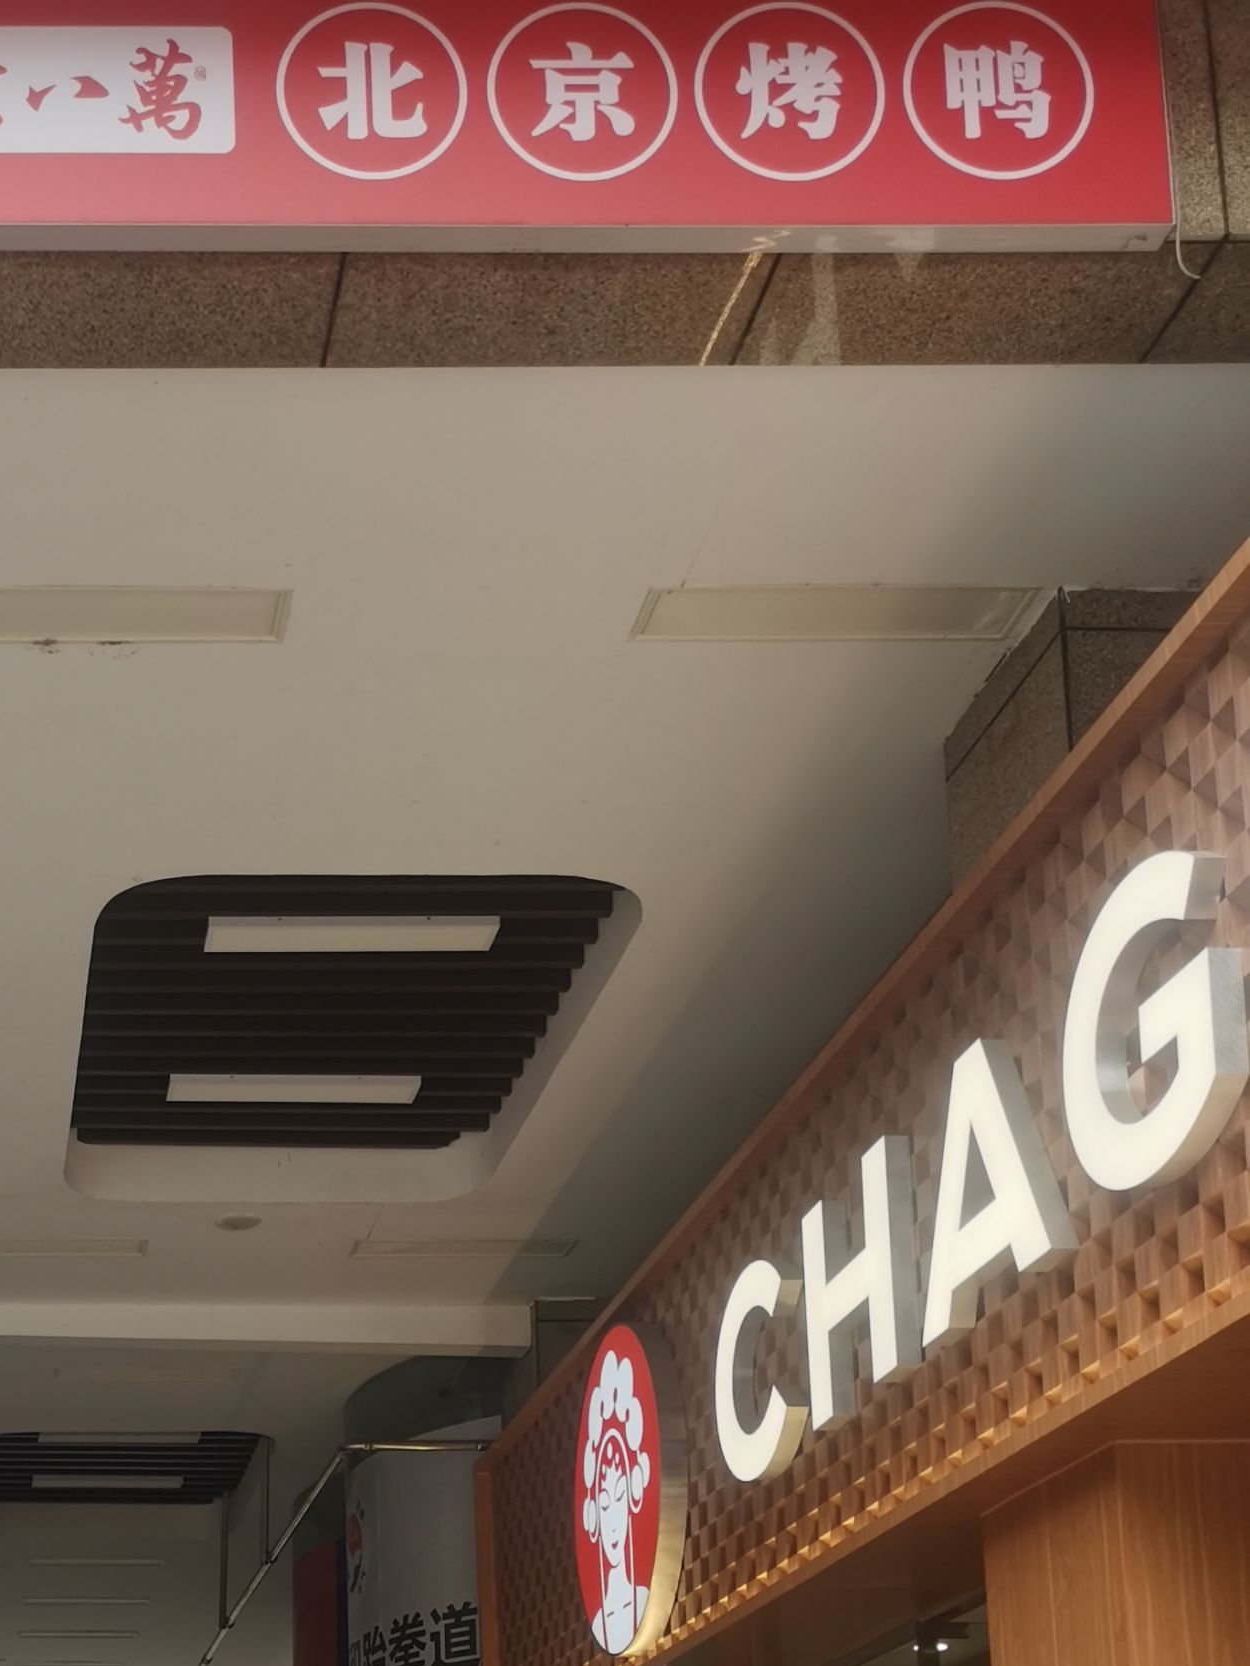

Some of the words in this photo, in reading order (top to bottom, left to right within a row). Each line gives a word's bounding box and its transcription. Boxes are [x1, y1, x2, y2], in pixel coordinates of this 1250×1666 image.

[316, 41, 1055, 142] 北京烤鸭
[714, 848, 1248, 1482] CHAG
